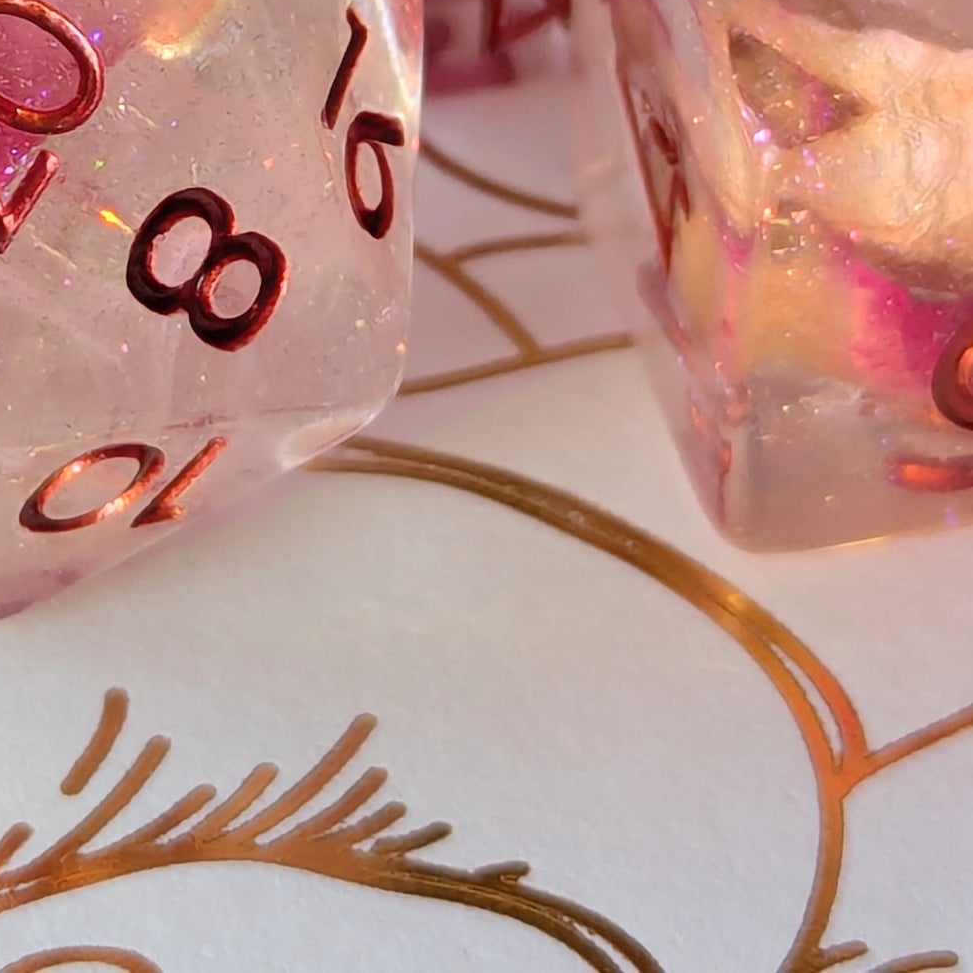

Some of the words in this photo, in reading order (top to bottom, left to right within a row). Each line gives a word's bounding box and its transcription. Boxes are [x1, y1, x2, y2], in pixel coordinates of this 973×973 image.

[320, 0, 406, 240] 16
[125, 187, 291, 353] 8
[18, 435, 231, 533] 10
